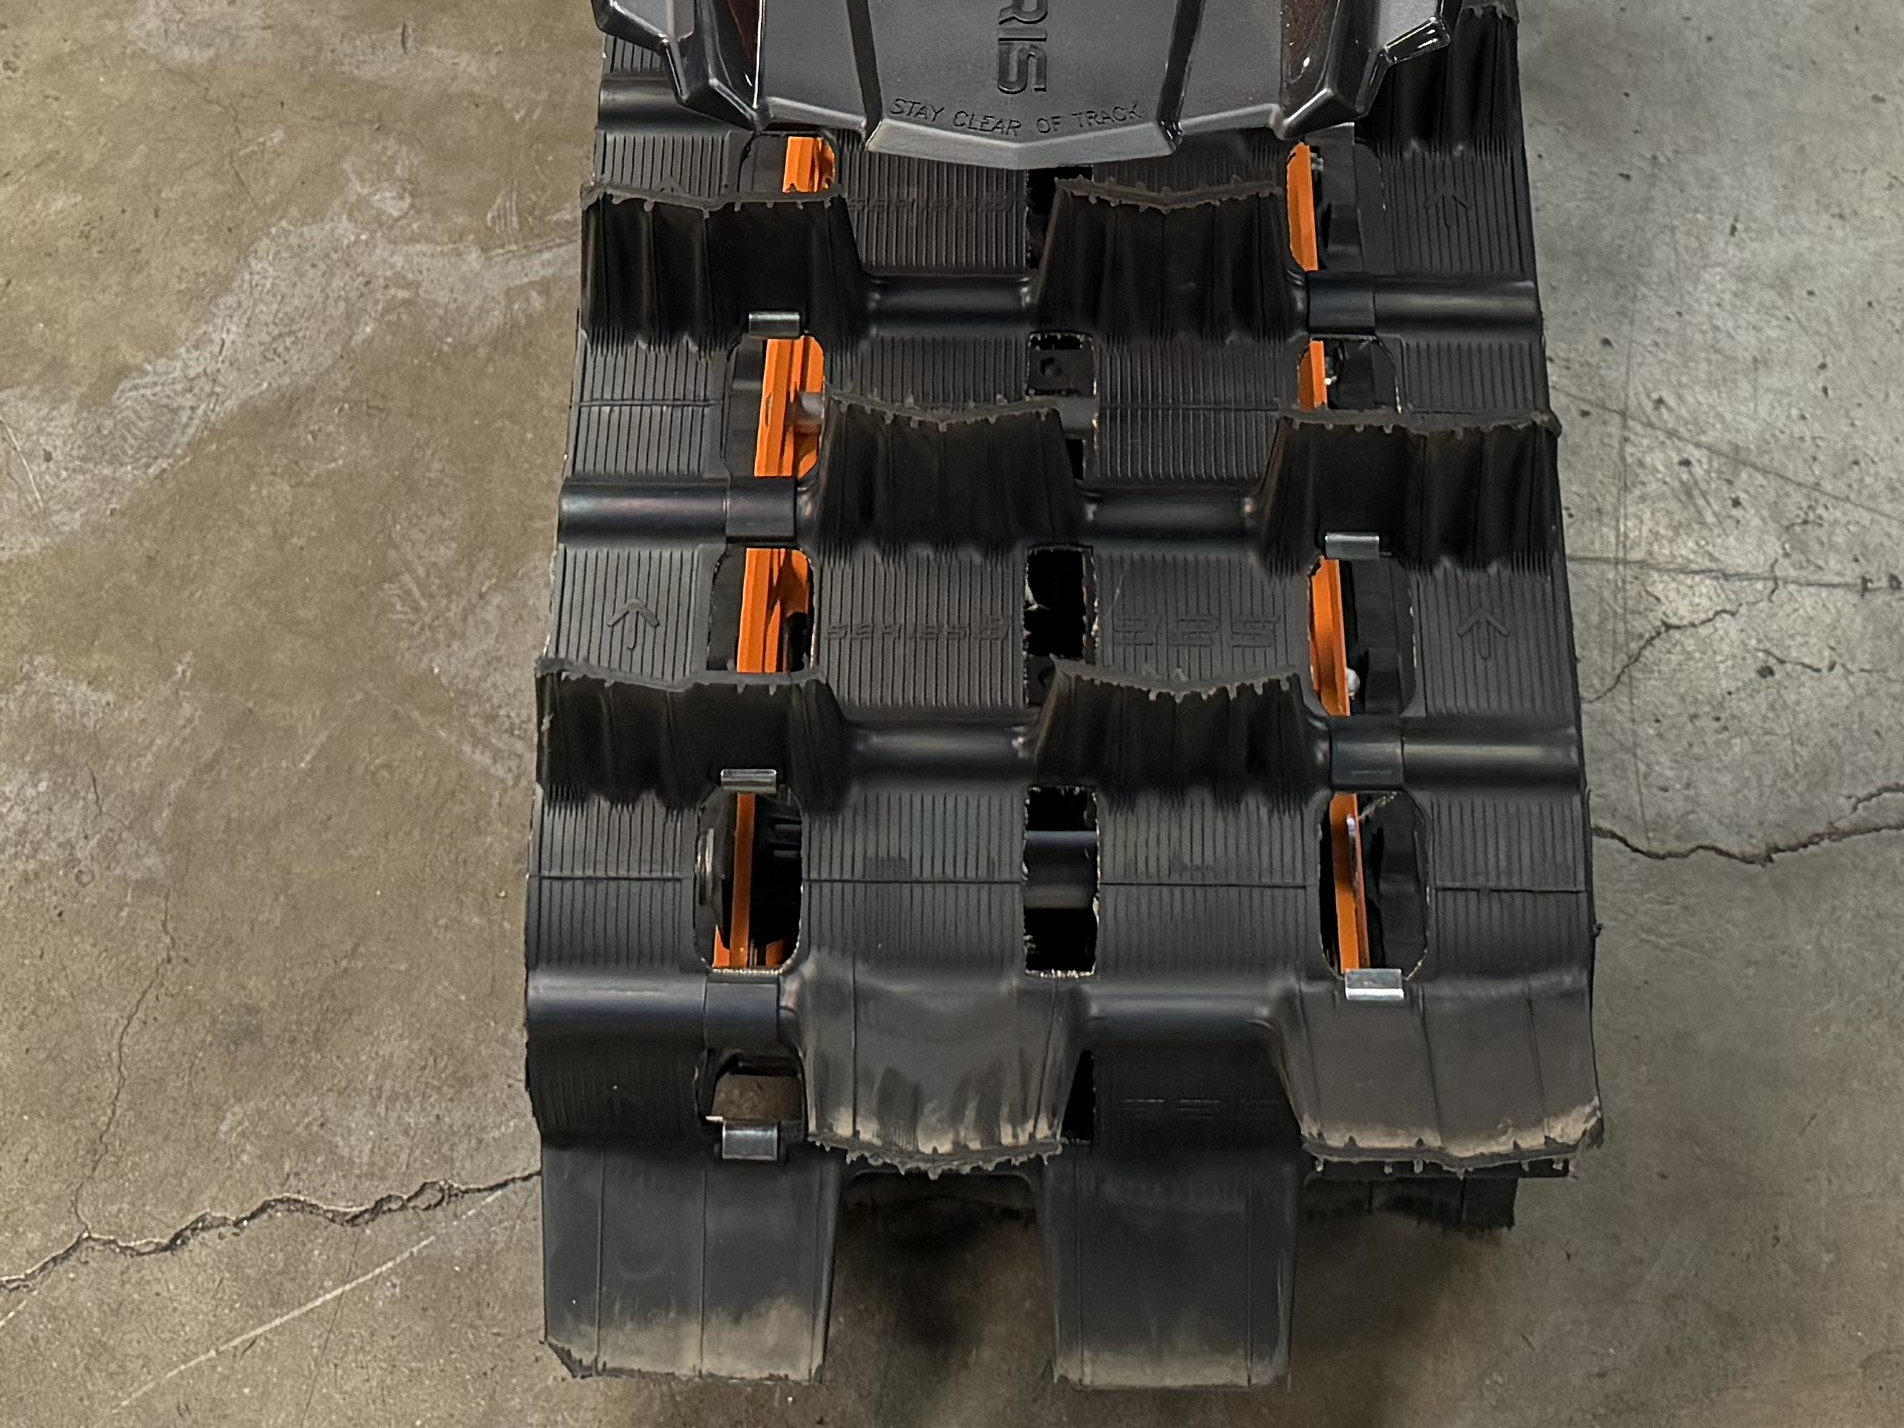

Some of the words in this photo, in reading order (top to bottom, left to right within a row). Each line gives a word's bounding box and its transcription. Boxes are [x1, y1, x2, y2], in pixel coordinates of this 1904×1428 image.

[888, 98, 945, 123] STAY
[953, 109, 1022, 137] CLEAR
[1036, 114, 1062, 134] OF
[1070, 101, 1143, 130] TRACK
